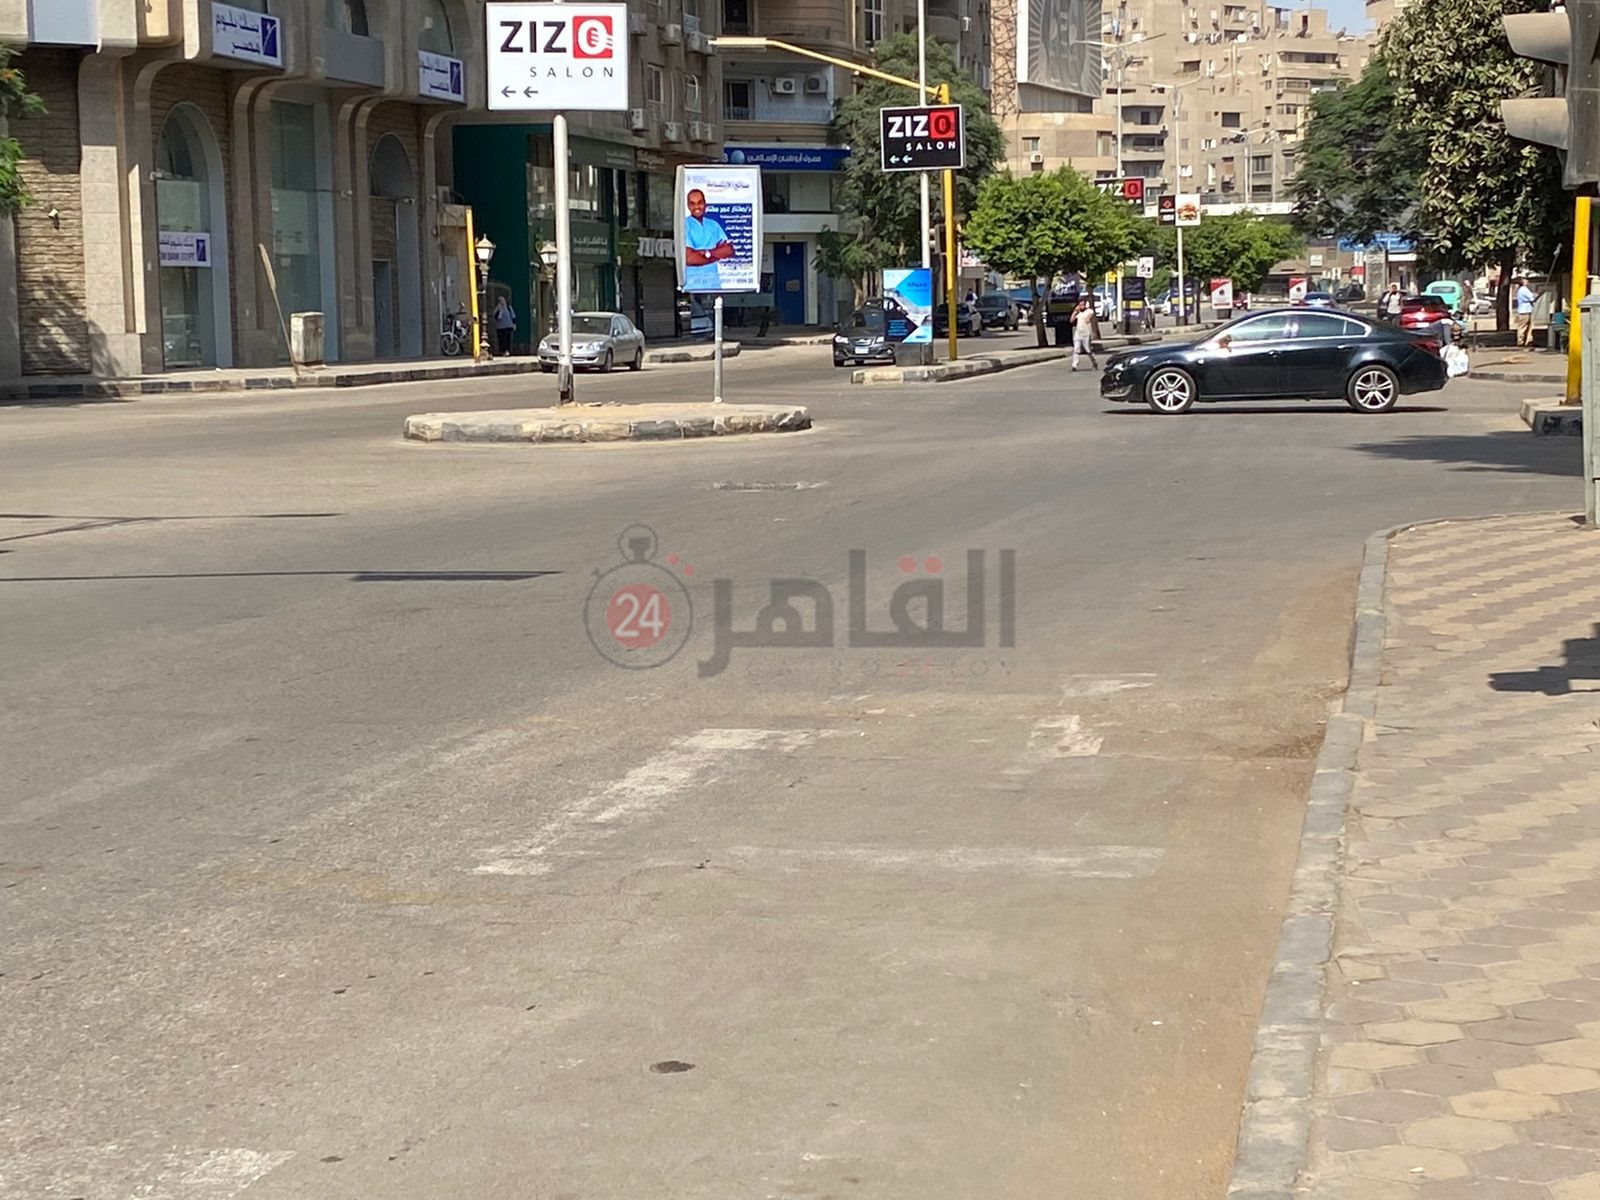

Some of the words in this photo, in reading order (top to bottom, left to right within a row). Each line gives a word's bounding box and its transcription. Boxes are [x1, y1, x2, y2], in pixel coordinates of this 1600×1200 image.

[500, 17, 612, 57] ZIZO
[530, 67, 613, 77] SALON
[887, 113, 953, 138] ZIZO
[905, 141, 956, 152] SALON
